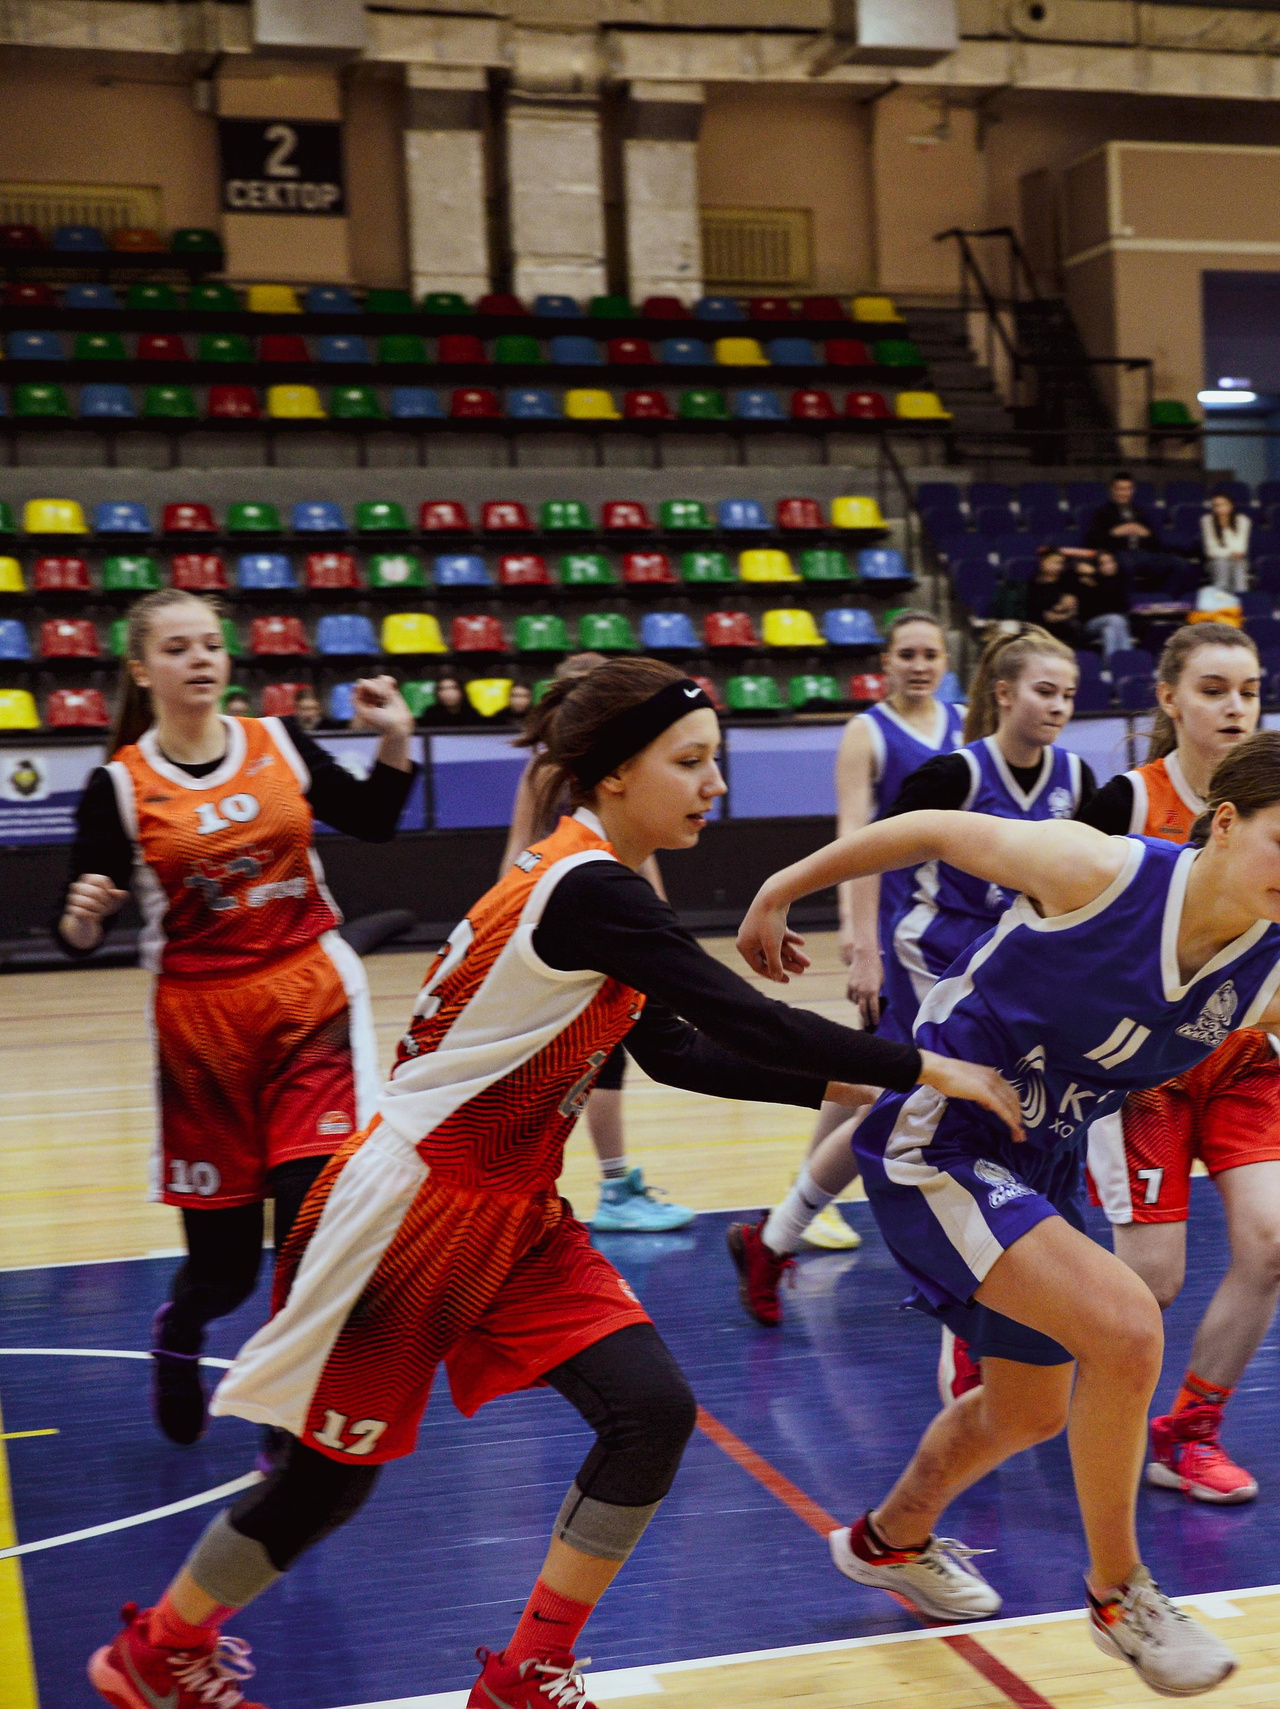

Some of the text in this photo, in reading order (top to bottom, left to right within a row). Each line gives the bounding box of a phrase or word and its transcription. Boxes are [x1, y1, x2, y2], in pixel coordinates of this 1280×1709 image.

[263, 124, 300, 178] 2
[225, 179, 340, 210] СЕКТОР
[193, 792, 261, 836] 10
[166, 1158, 222, 1196] 10
[1136, 1167, 1165, 1205] 7
